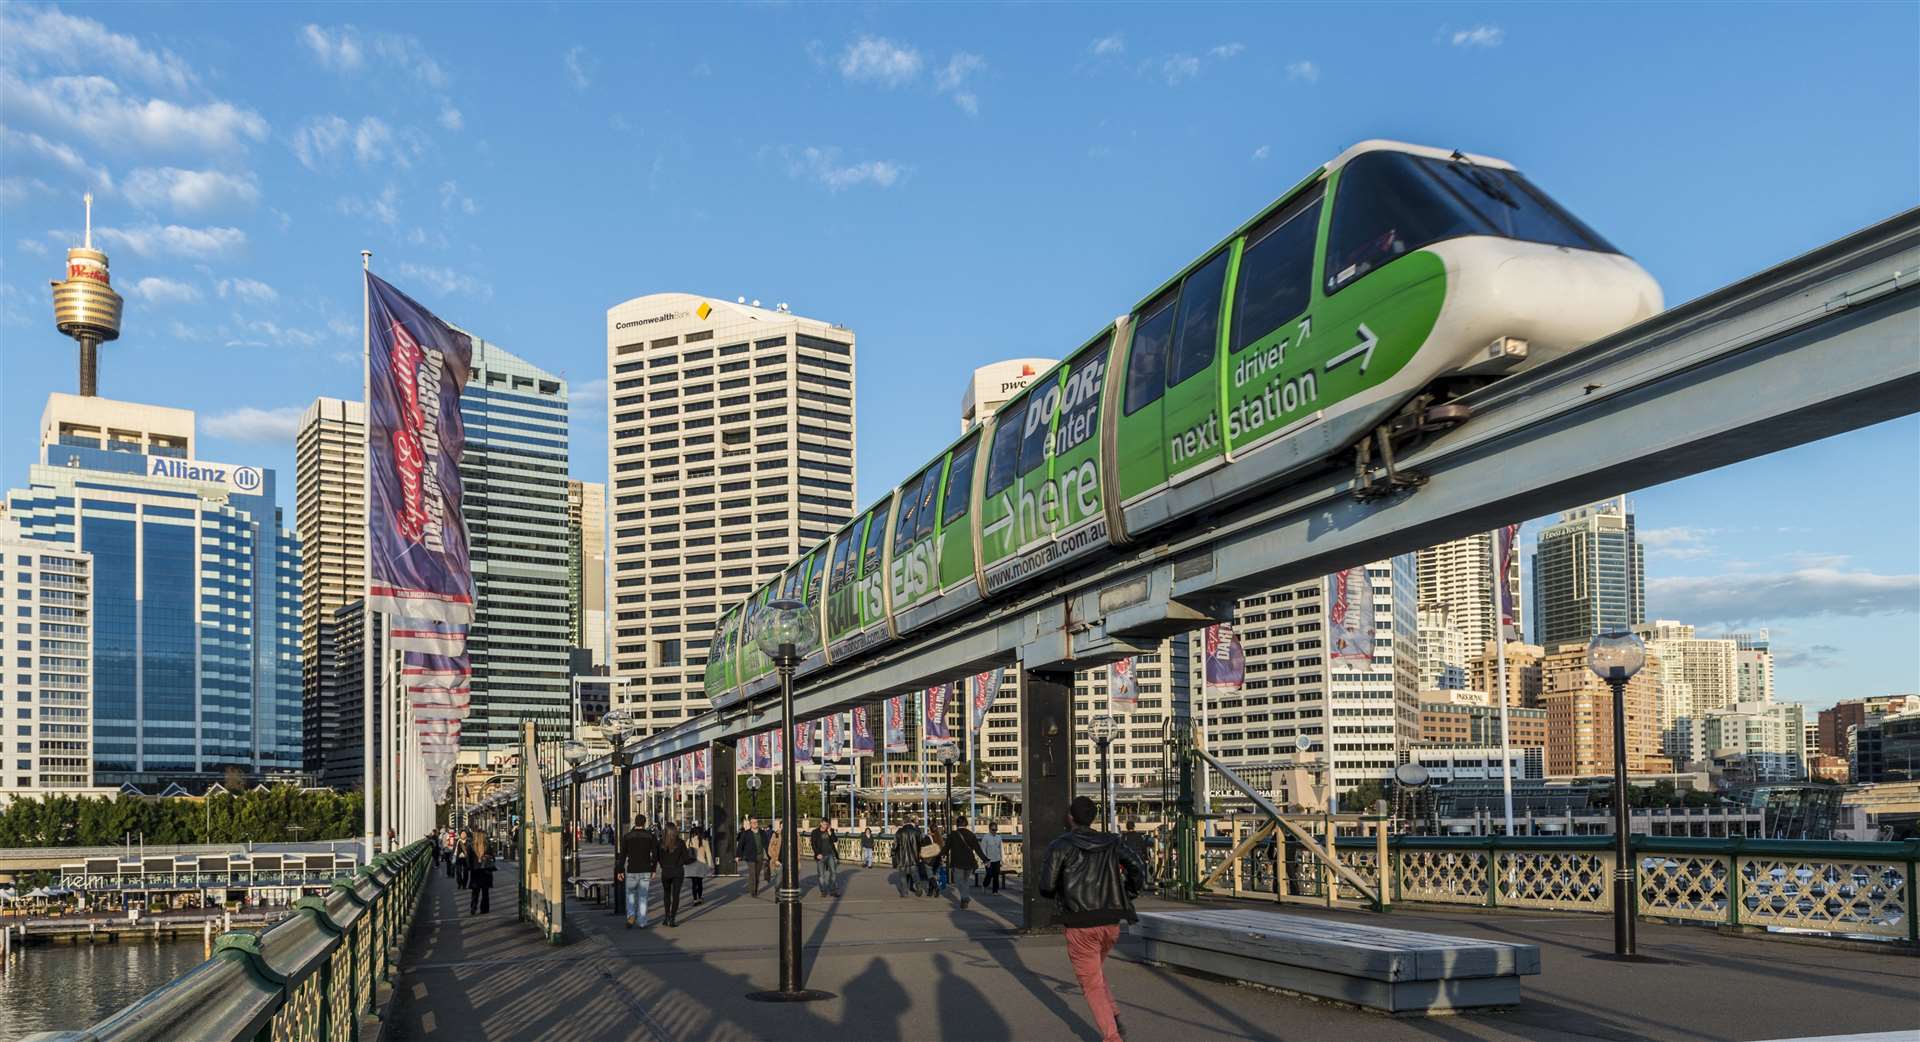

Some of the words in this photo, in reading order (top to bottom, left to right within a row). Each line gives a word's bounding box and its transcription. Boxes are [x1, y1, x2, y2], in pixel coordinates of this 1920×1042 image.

[1001, 380, 1027, 393] pwc
[1235, 338, 1289, 388] driver
[417, 345, 444, 456] HARBOUR
[1043, 405, 1097, 460] enter
[1171, 413, 1219, 464] next
[1229, 371, 1317, 440] station
[152, 458, 225, 483] Allianz
[1020, 459, 1098, 544] here
[891, 533, 946, 612] EASY
[986, 521, 1107, 590] www.monorail.com.au
